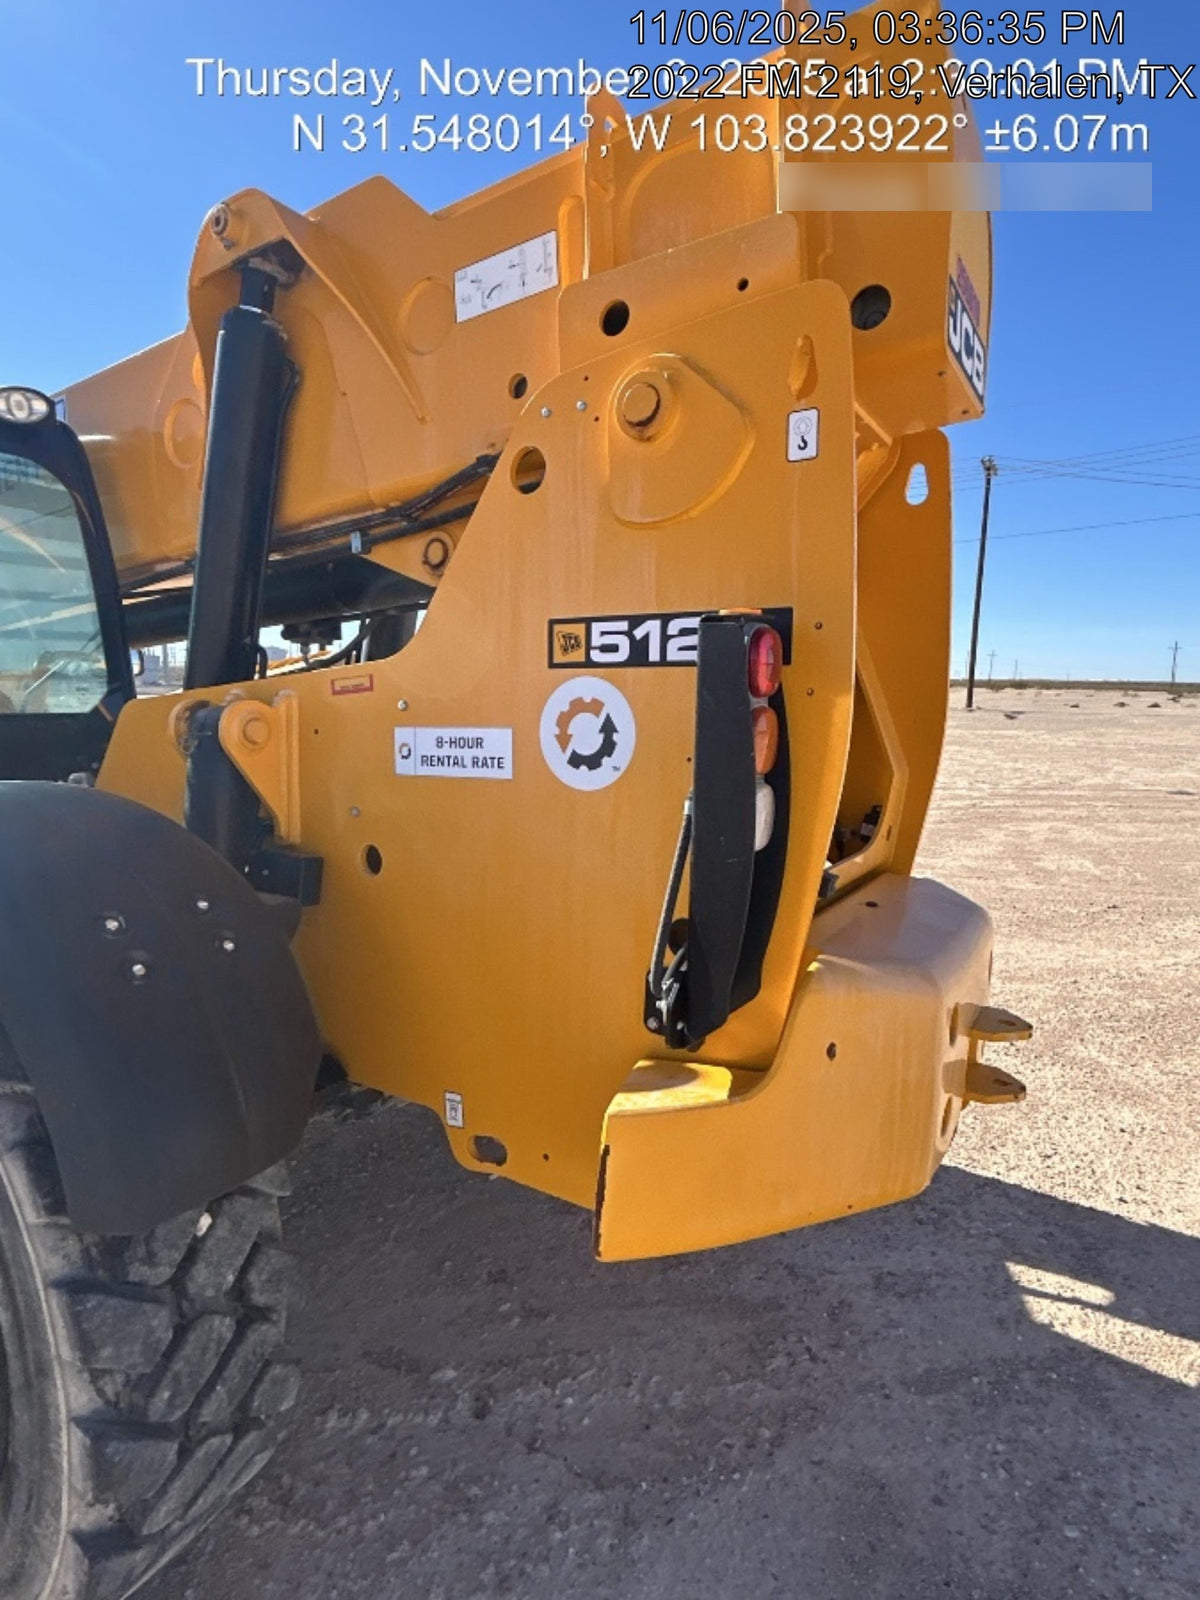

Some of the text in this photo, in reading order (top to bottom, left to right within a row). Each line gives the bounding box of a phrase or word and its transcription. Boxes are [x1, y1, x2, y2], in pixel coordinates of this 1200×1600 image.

[949, 296, 985, 397] JCB
[435, 735, 484, 750] 8-HOUR
[420, 755, 505, 770] RENTAL RATE
